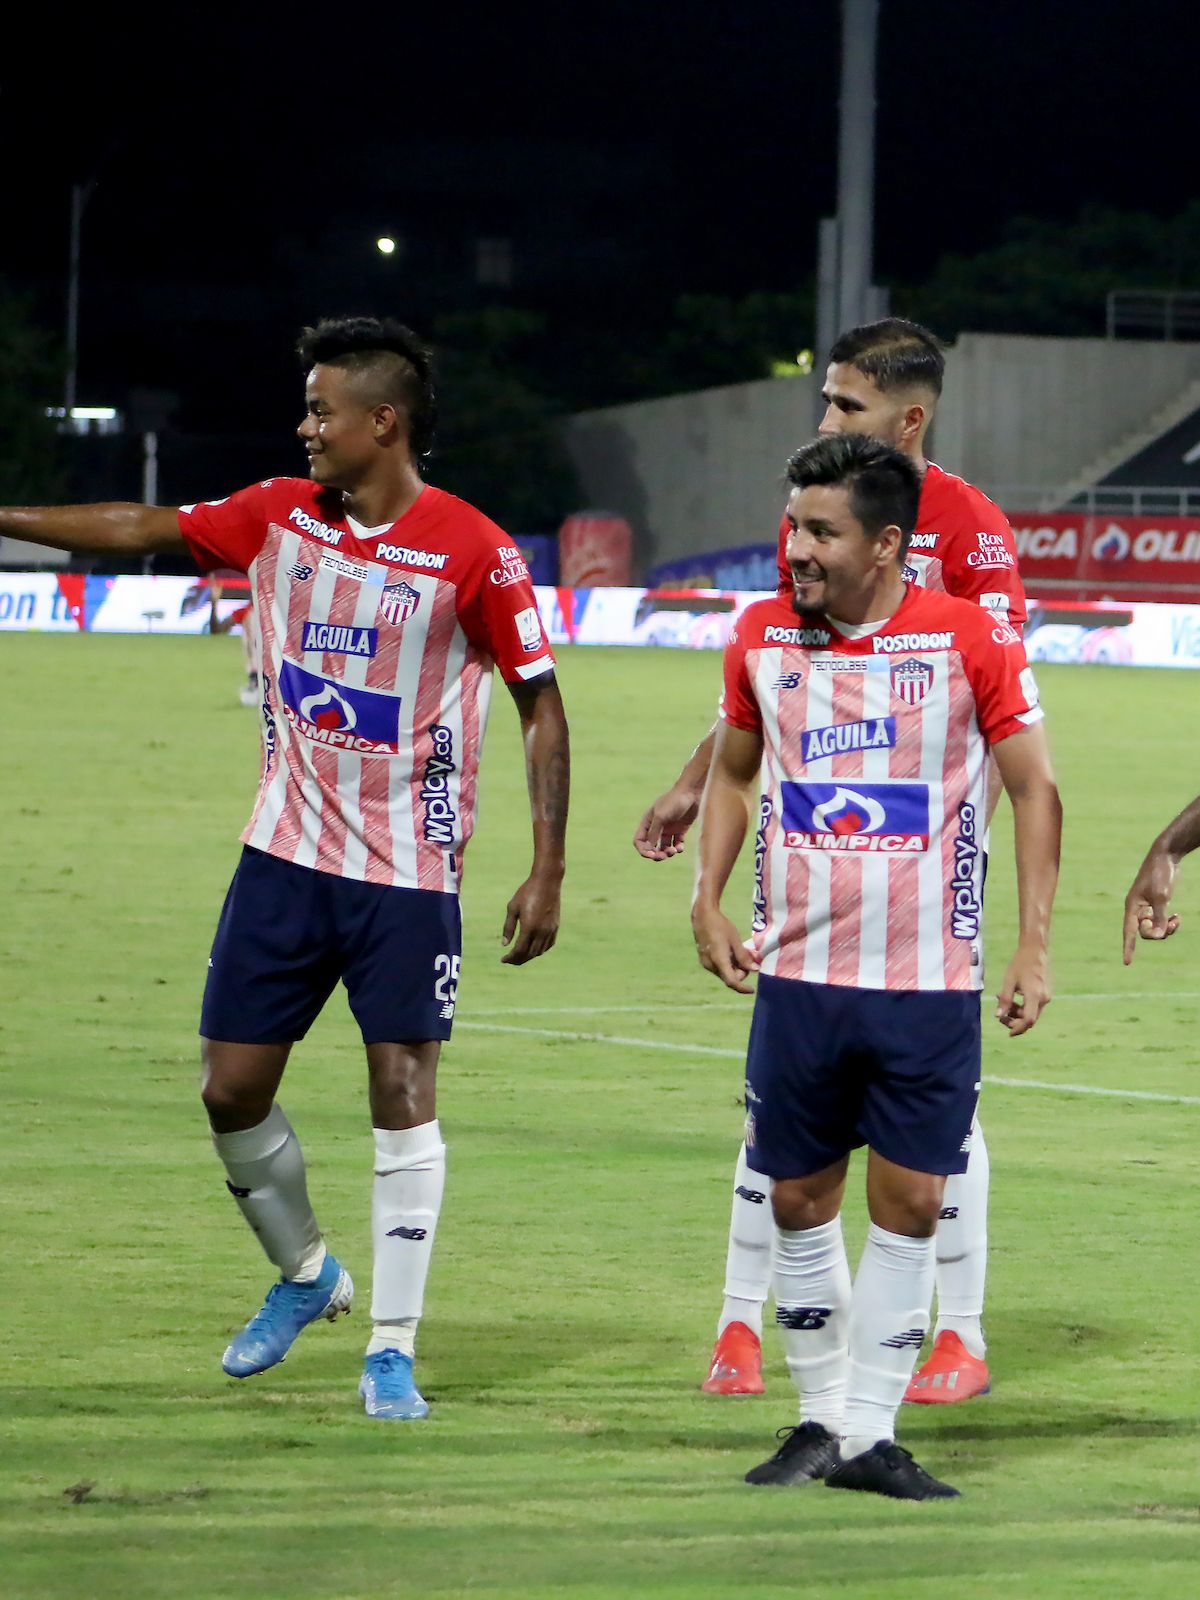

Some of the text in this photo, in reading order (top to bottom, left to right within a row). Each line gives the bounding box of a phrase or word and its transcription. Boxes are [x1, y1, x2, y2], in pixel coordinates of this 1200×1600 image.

[304, 624, 371, 655] AGUILA
[897, 674, 927, 682] JUNIOR
[805, 718, 891, 760] AGUILA
[787, 832, 925, 851] OLIMPICA
